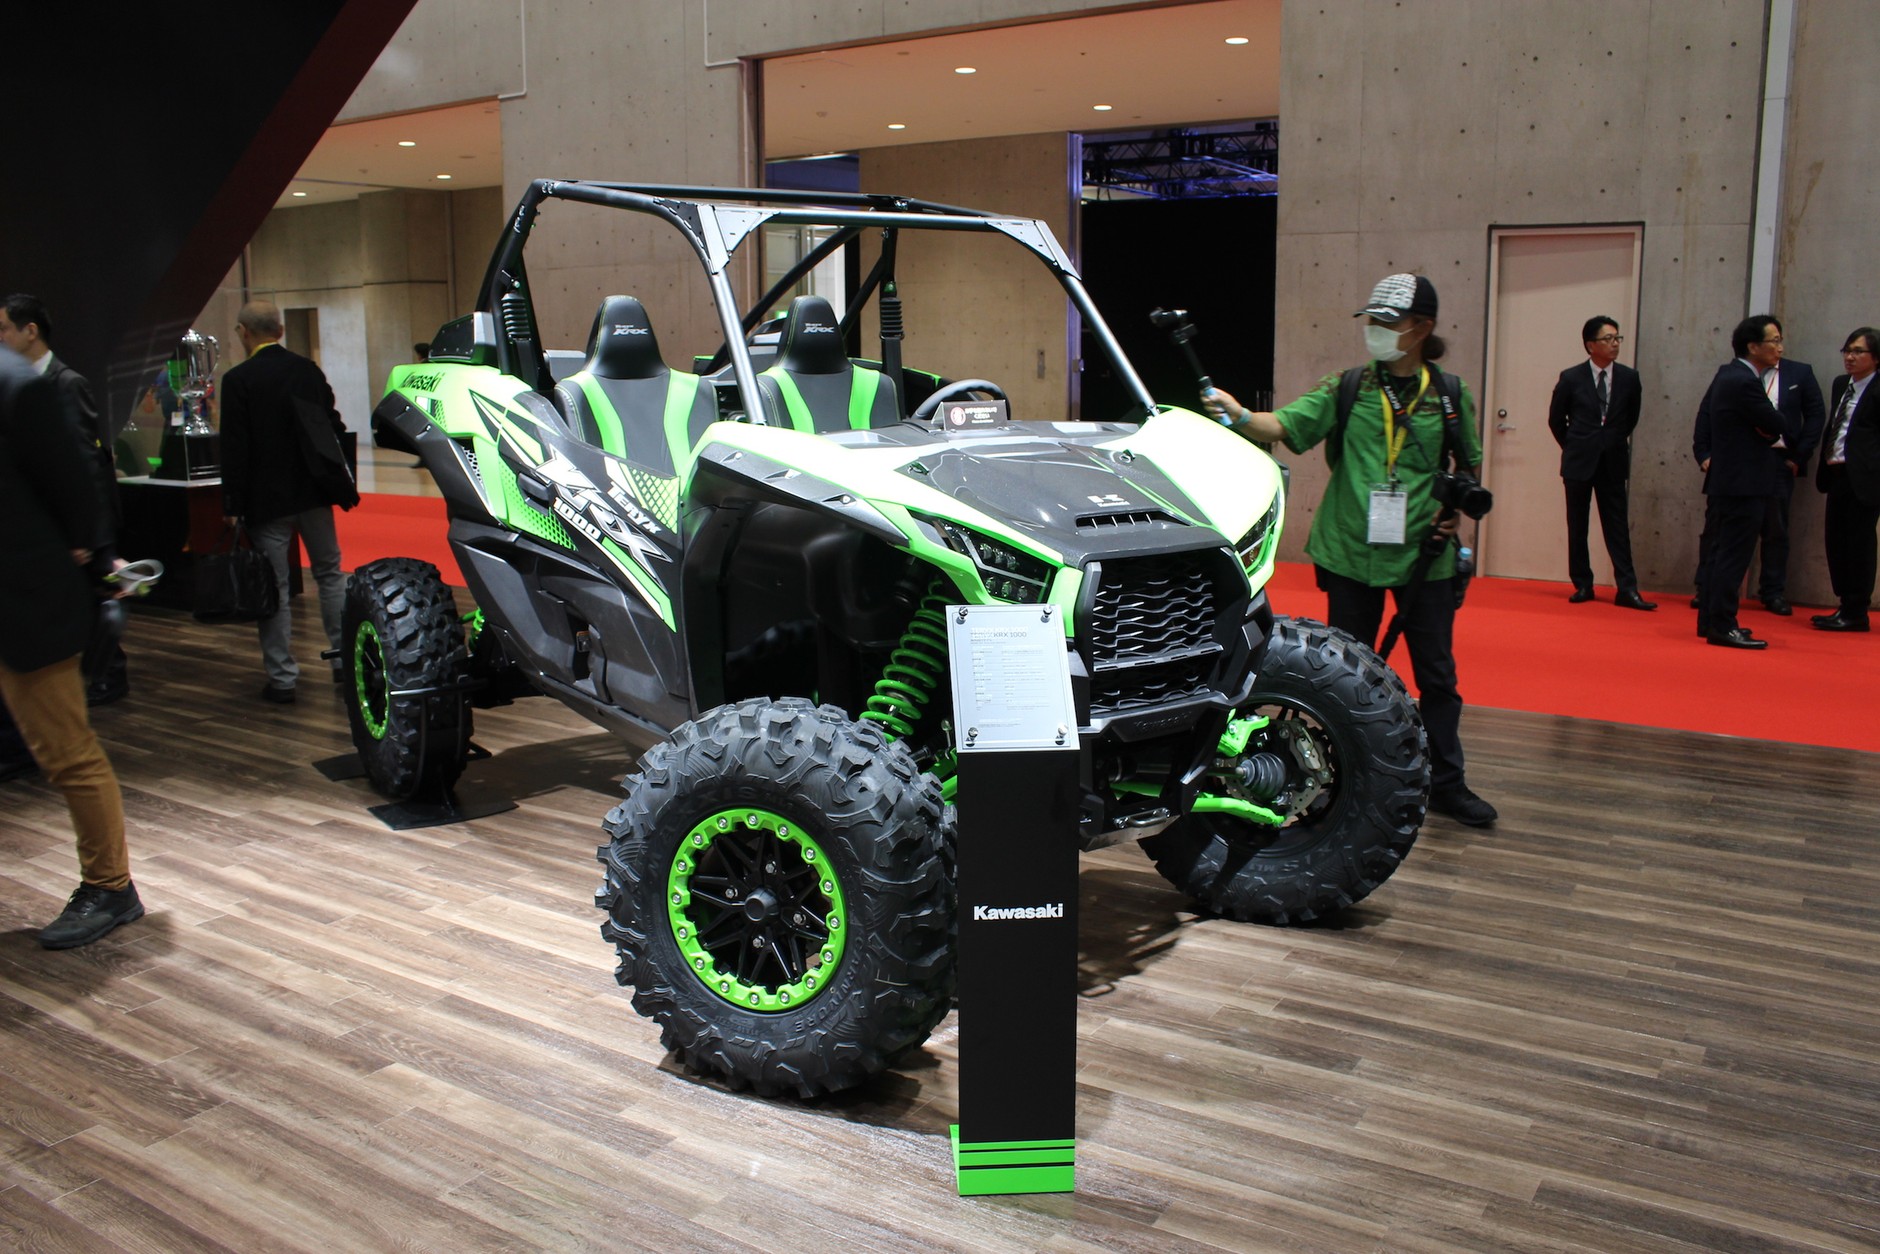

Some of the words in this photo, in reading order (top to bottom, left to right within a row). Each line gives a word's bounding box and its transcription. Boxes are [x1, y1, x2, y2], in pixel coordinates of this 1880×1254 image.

[535, 443, 673, 595] KRX
[553, 496, 602, 541] 1000
[607, 480, 662, 534] TERYX
[973, 903, 1064, 921] Kawasaki
